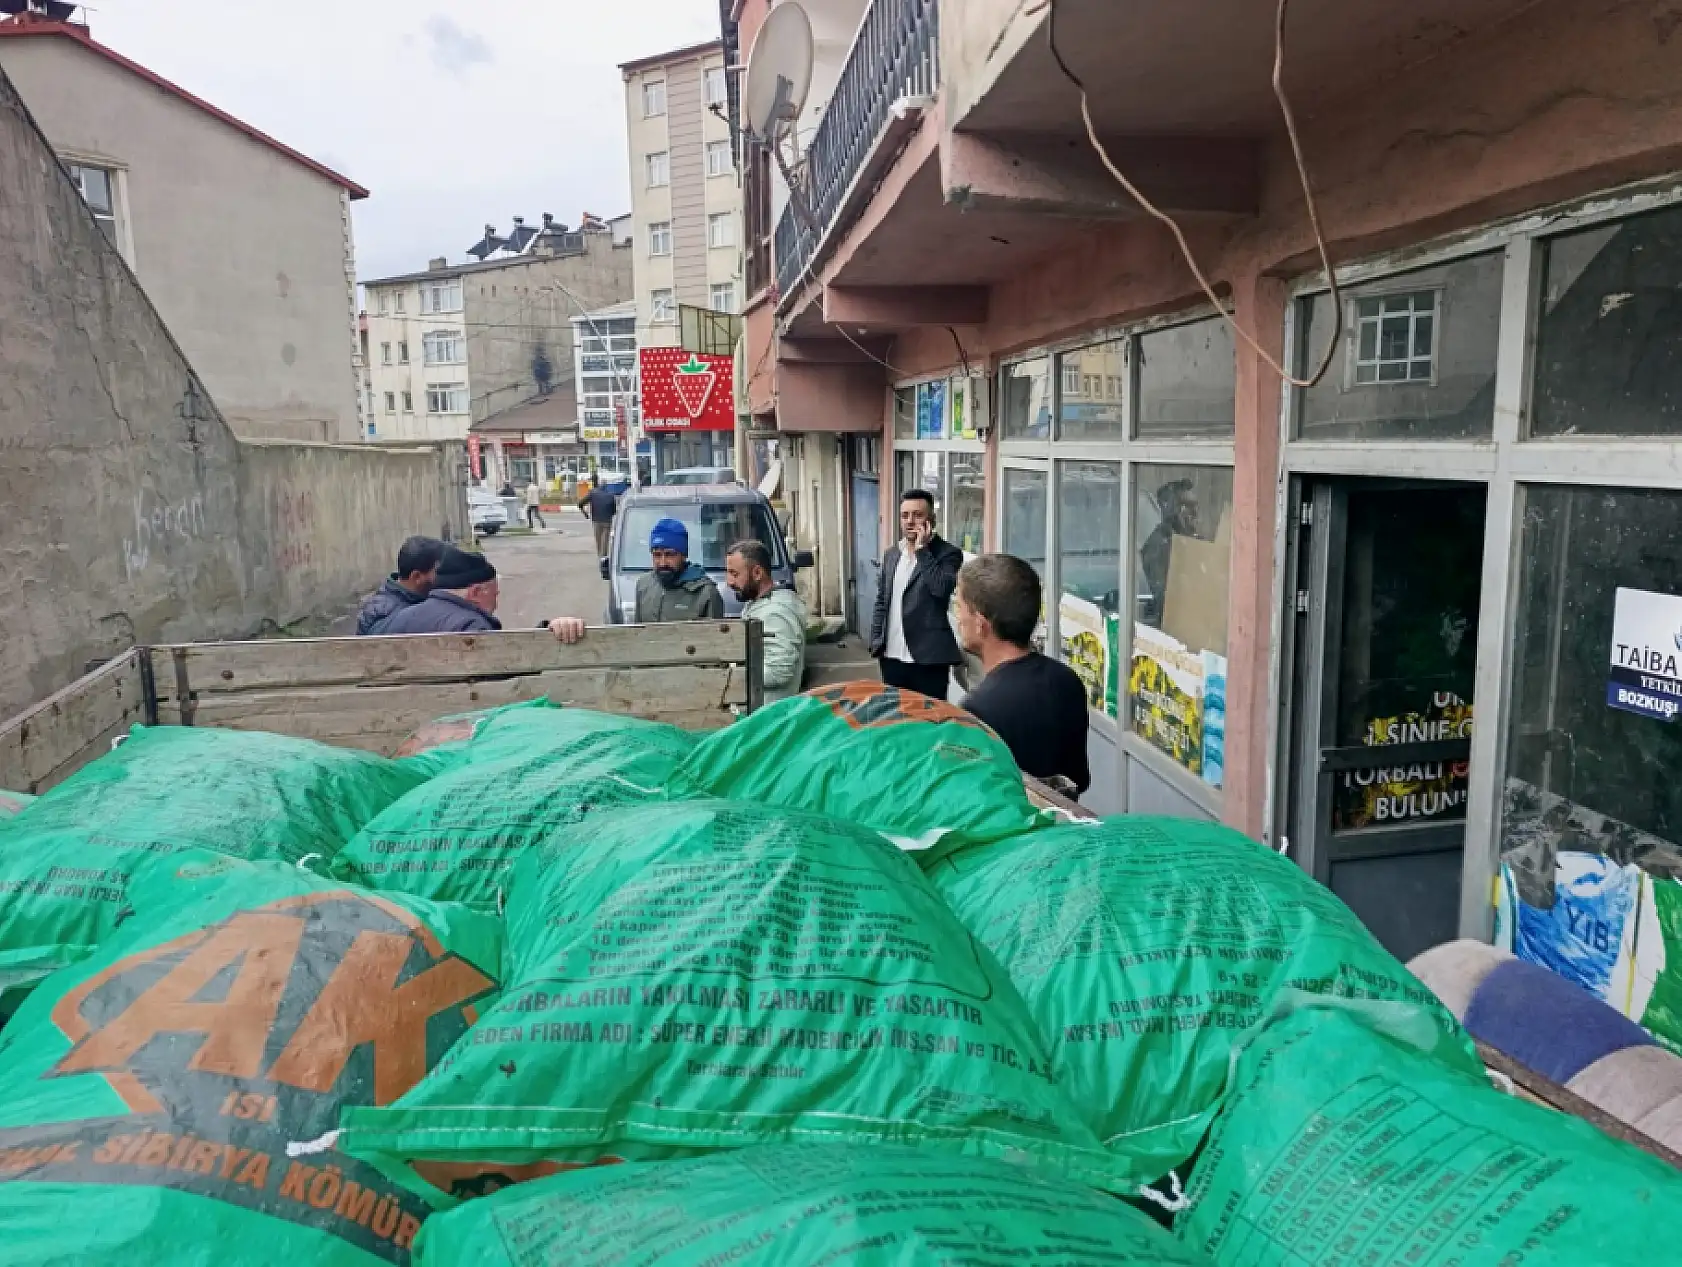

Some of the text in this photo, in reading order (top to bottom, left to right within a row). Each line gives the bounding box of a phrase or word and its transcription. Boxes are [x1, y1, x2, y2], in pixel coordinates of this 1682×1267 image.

[1616, 643, 1678, 677] TAİBA
[1387, 719, 1450, 744] SINIF
[55, 913, 496, 1108] AK
[757, 988, 845, 1015] ZARARLI
[853, 993, 877, 1018] VE
[883, 992, 983, 1026] YASAKTIR
[92, 1126, 271, 1190] SİBİRYA
